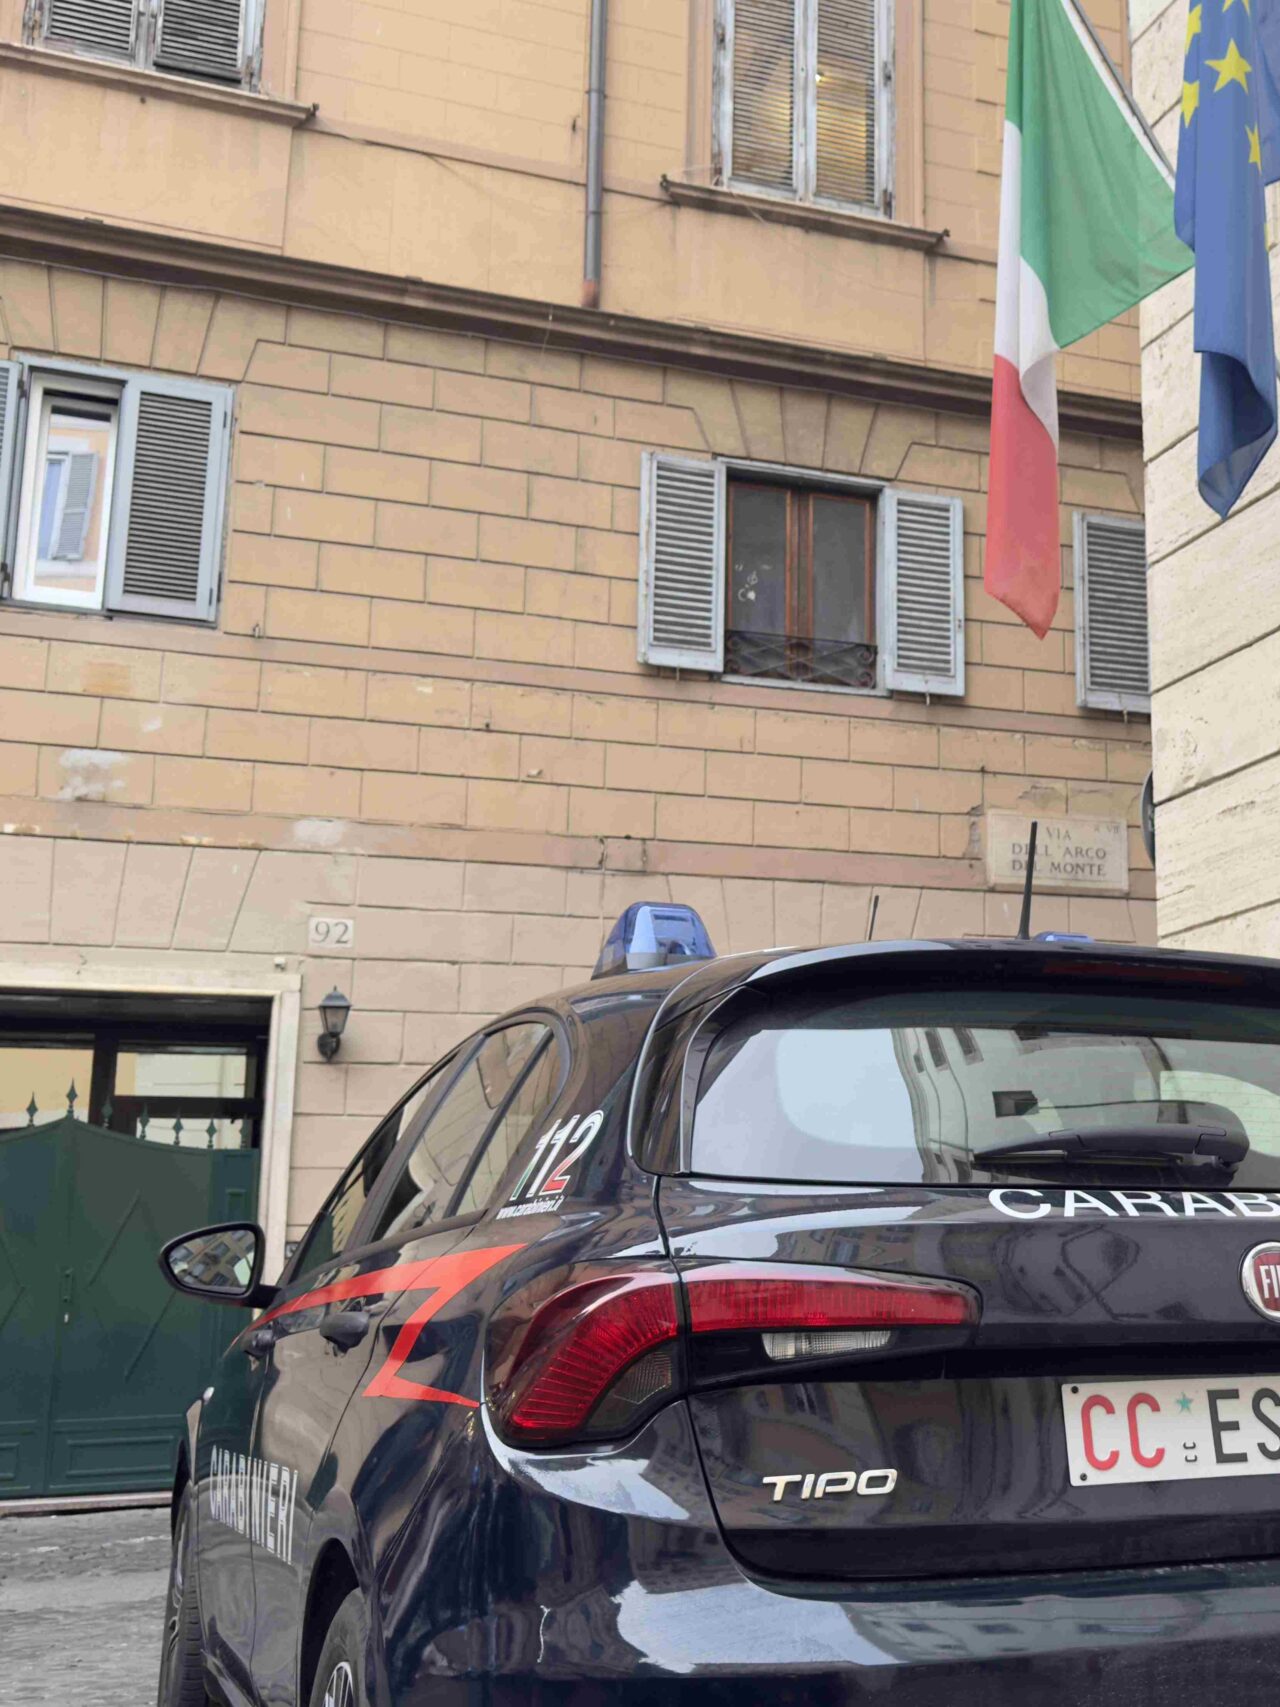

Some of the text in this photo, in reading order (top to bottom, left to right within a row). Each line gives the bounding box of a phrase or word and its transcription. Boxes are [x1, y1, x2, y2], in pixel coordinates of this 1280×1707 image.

[1045, 825, 1072, 841] VIA
[1050, 862, 1107, 877] MONTE
[311, 920, 350, 945] 92
[509, 1109, 605, 1202] 112
[1081, 1391, 1165, 1471] CC
[762, 1468, 898, 1502] TIPO
[209, 1444, 298, 1566] CARABINIERI
